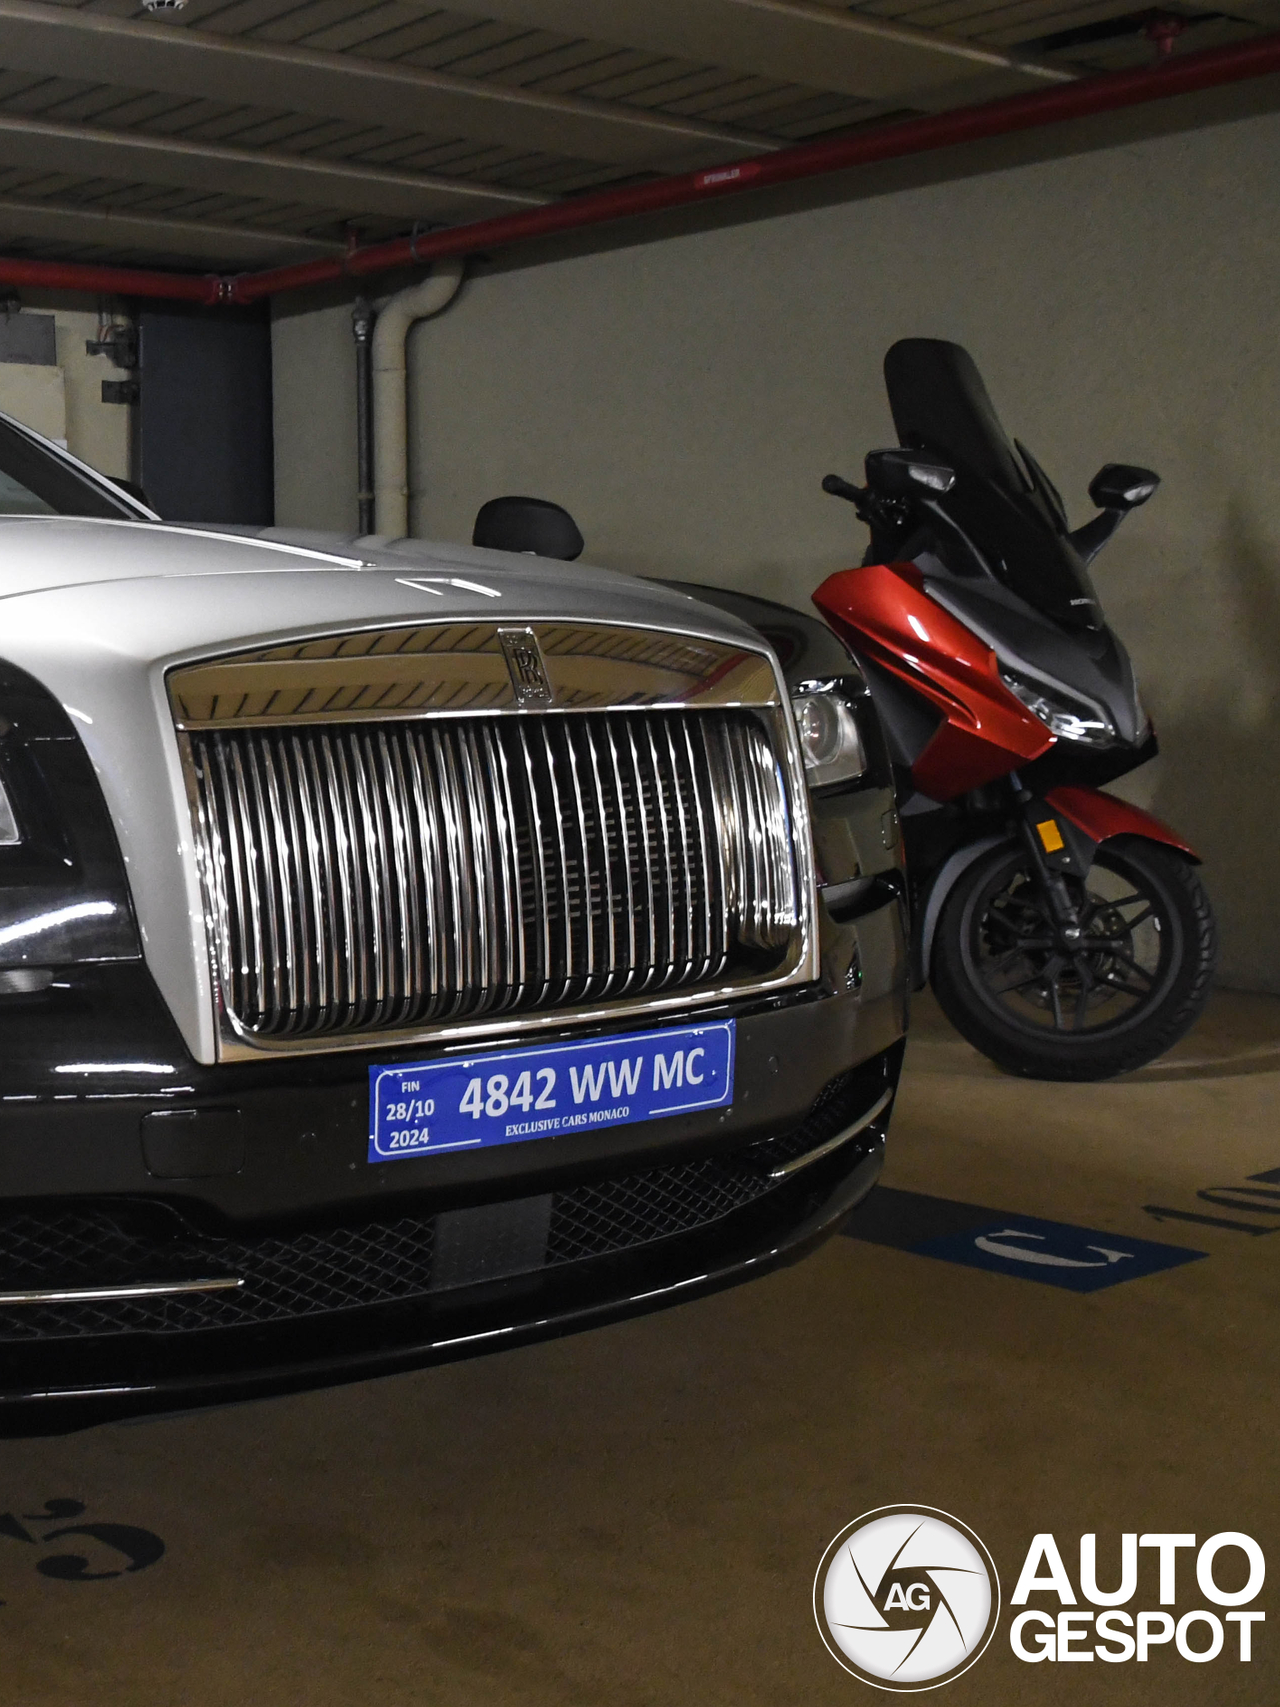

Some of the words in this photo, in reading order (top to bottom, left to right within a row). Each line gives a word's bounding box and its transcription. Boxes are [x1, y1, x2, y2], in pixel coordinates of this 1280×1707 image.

[401, 1080, 420, 1093] FIN
[459, 1067, 557, 1119] 4842
[568, 1056, 643, 1104] WW
[652, 1047, 705, 1092] MC
[386, 1099, 435, 1122] 28/10
[505, 1117, 561, 1137] EXCLUSIVE
[562, 1113, 588, 1128] CARS
[588, 1106, 630, 1124] MONACO
[389, 1127, 430, 1149] 2024
